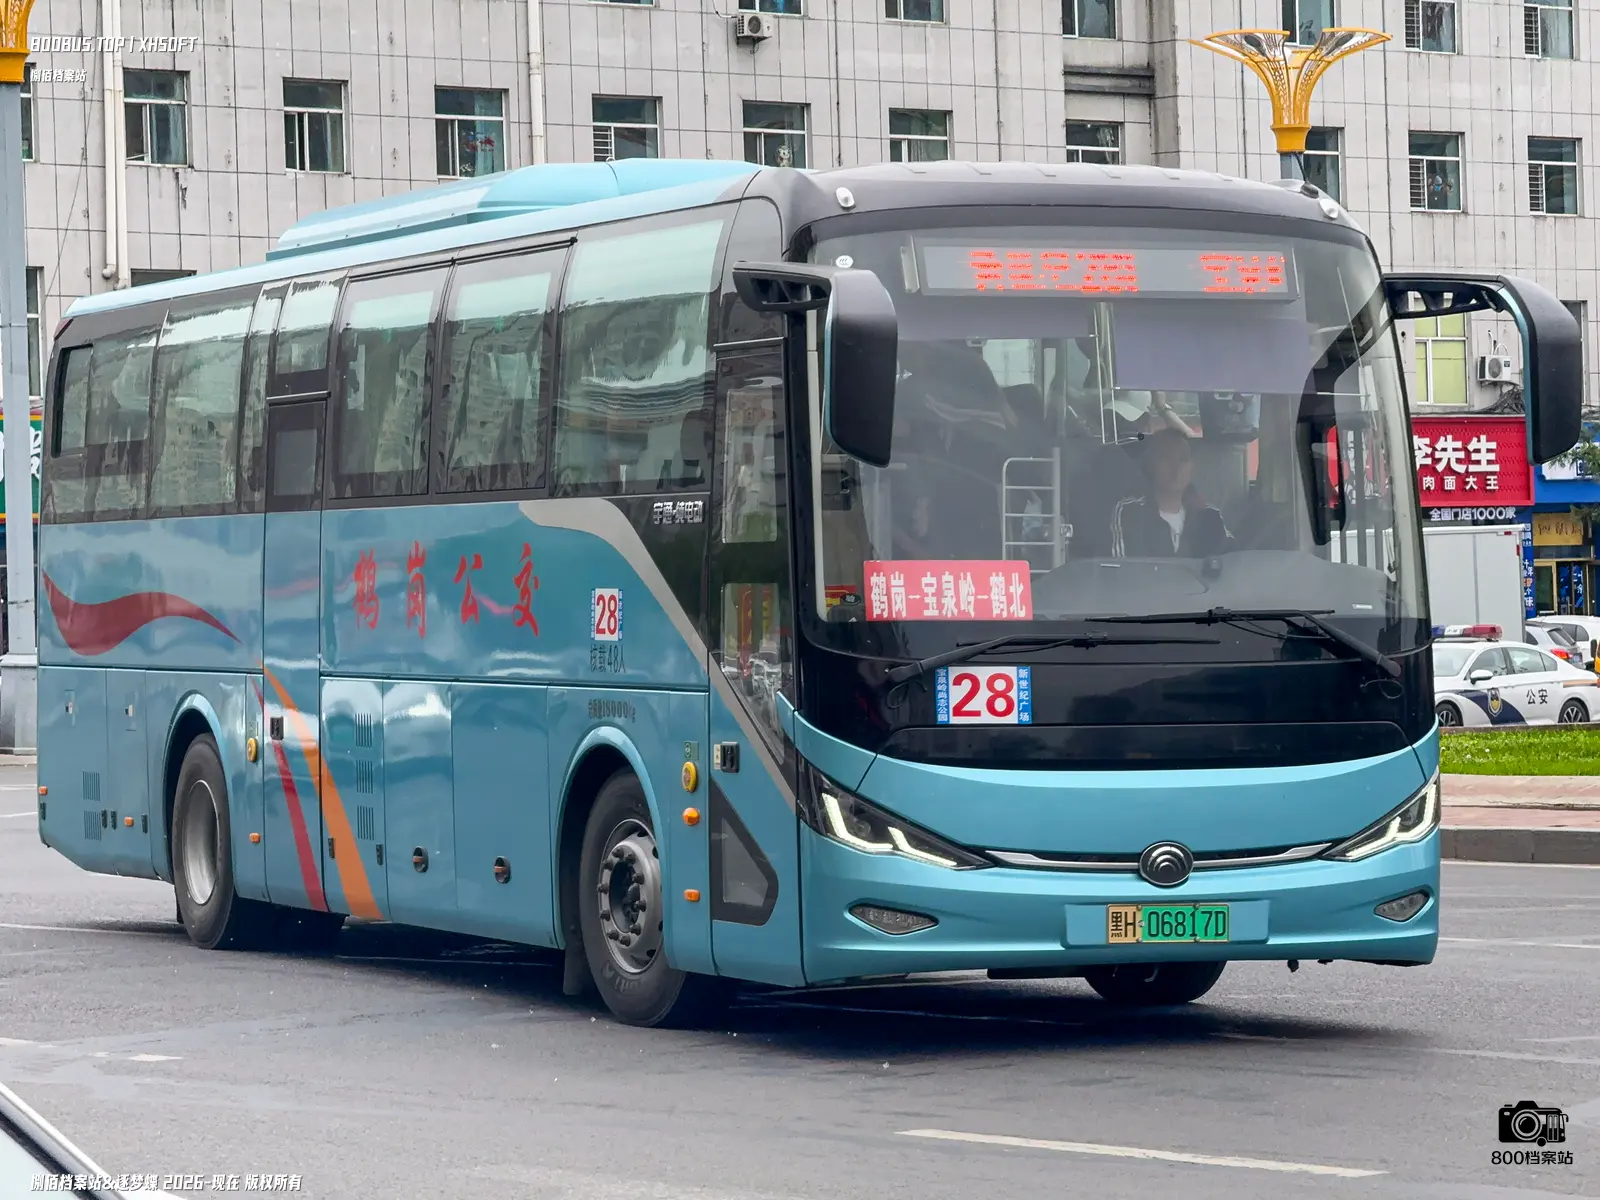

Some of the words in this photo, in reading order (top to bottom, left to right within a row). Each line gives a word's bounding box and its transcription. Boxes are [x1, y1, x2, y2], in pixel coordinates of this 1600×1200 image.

[1428, 507, 1516, 521] 全国门店1000家
[595, 593, 618, 636] 28
[952, 672, 1015, 718] 28
[1018, 668, 1030, 722] 新世纪广场
[1526, 688, 1548, 705] 公安
